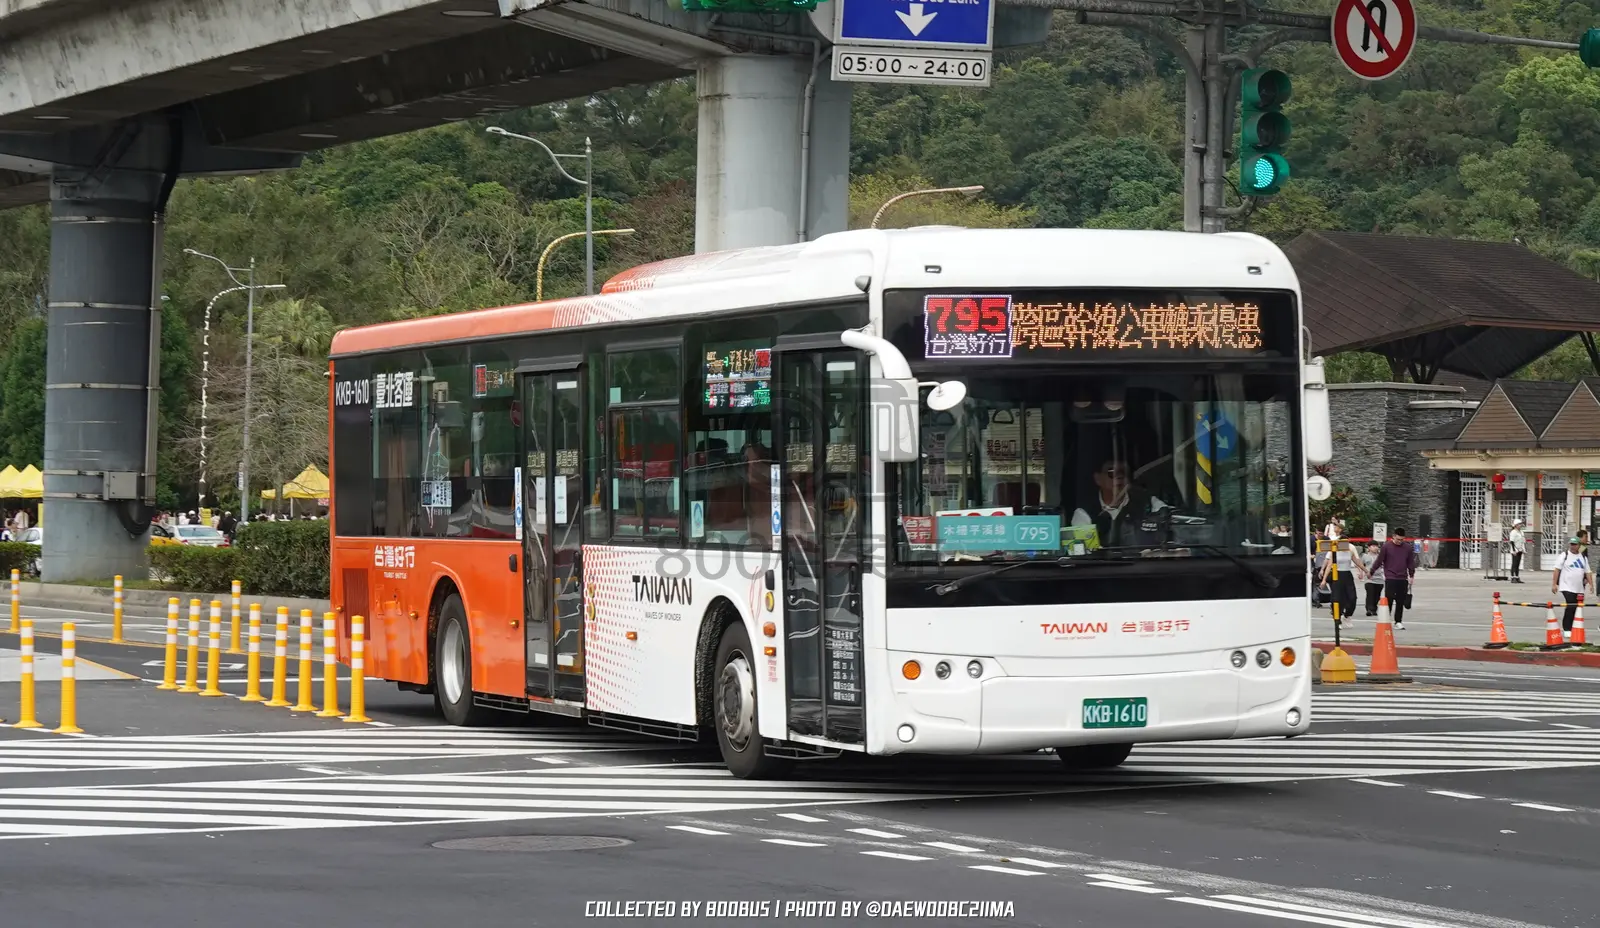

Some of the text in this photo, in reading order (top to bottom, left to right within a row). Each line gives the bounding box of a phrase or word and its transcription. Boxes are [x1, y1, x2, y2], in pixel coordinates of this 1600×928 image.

[842, 56, 902, 74] 05:00
[923, 60, 984, 78] 24:00
[927, 298, 1007, 332] 795
[929, 333, 1008, 355] 台灣好行
[335, 378, 369, 406] KKB-1610
[375, 371, 414, 409] 臺北客運
[1019, 526, 1049, 541] 795
[374, 544, 416, 569] 台灣好行
[633, 575, 692, 605] TAIWAN
[1040, 622, 1108, 634] TAIWAN
[1121, 620, 1190, 633] 台灣好行
[1083, 703, 1147, 723] KKB-1610
